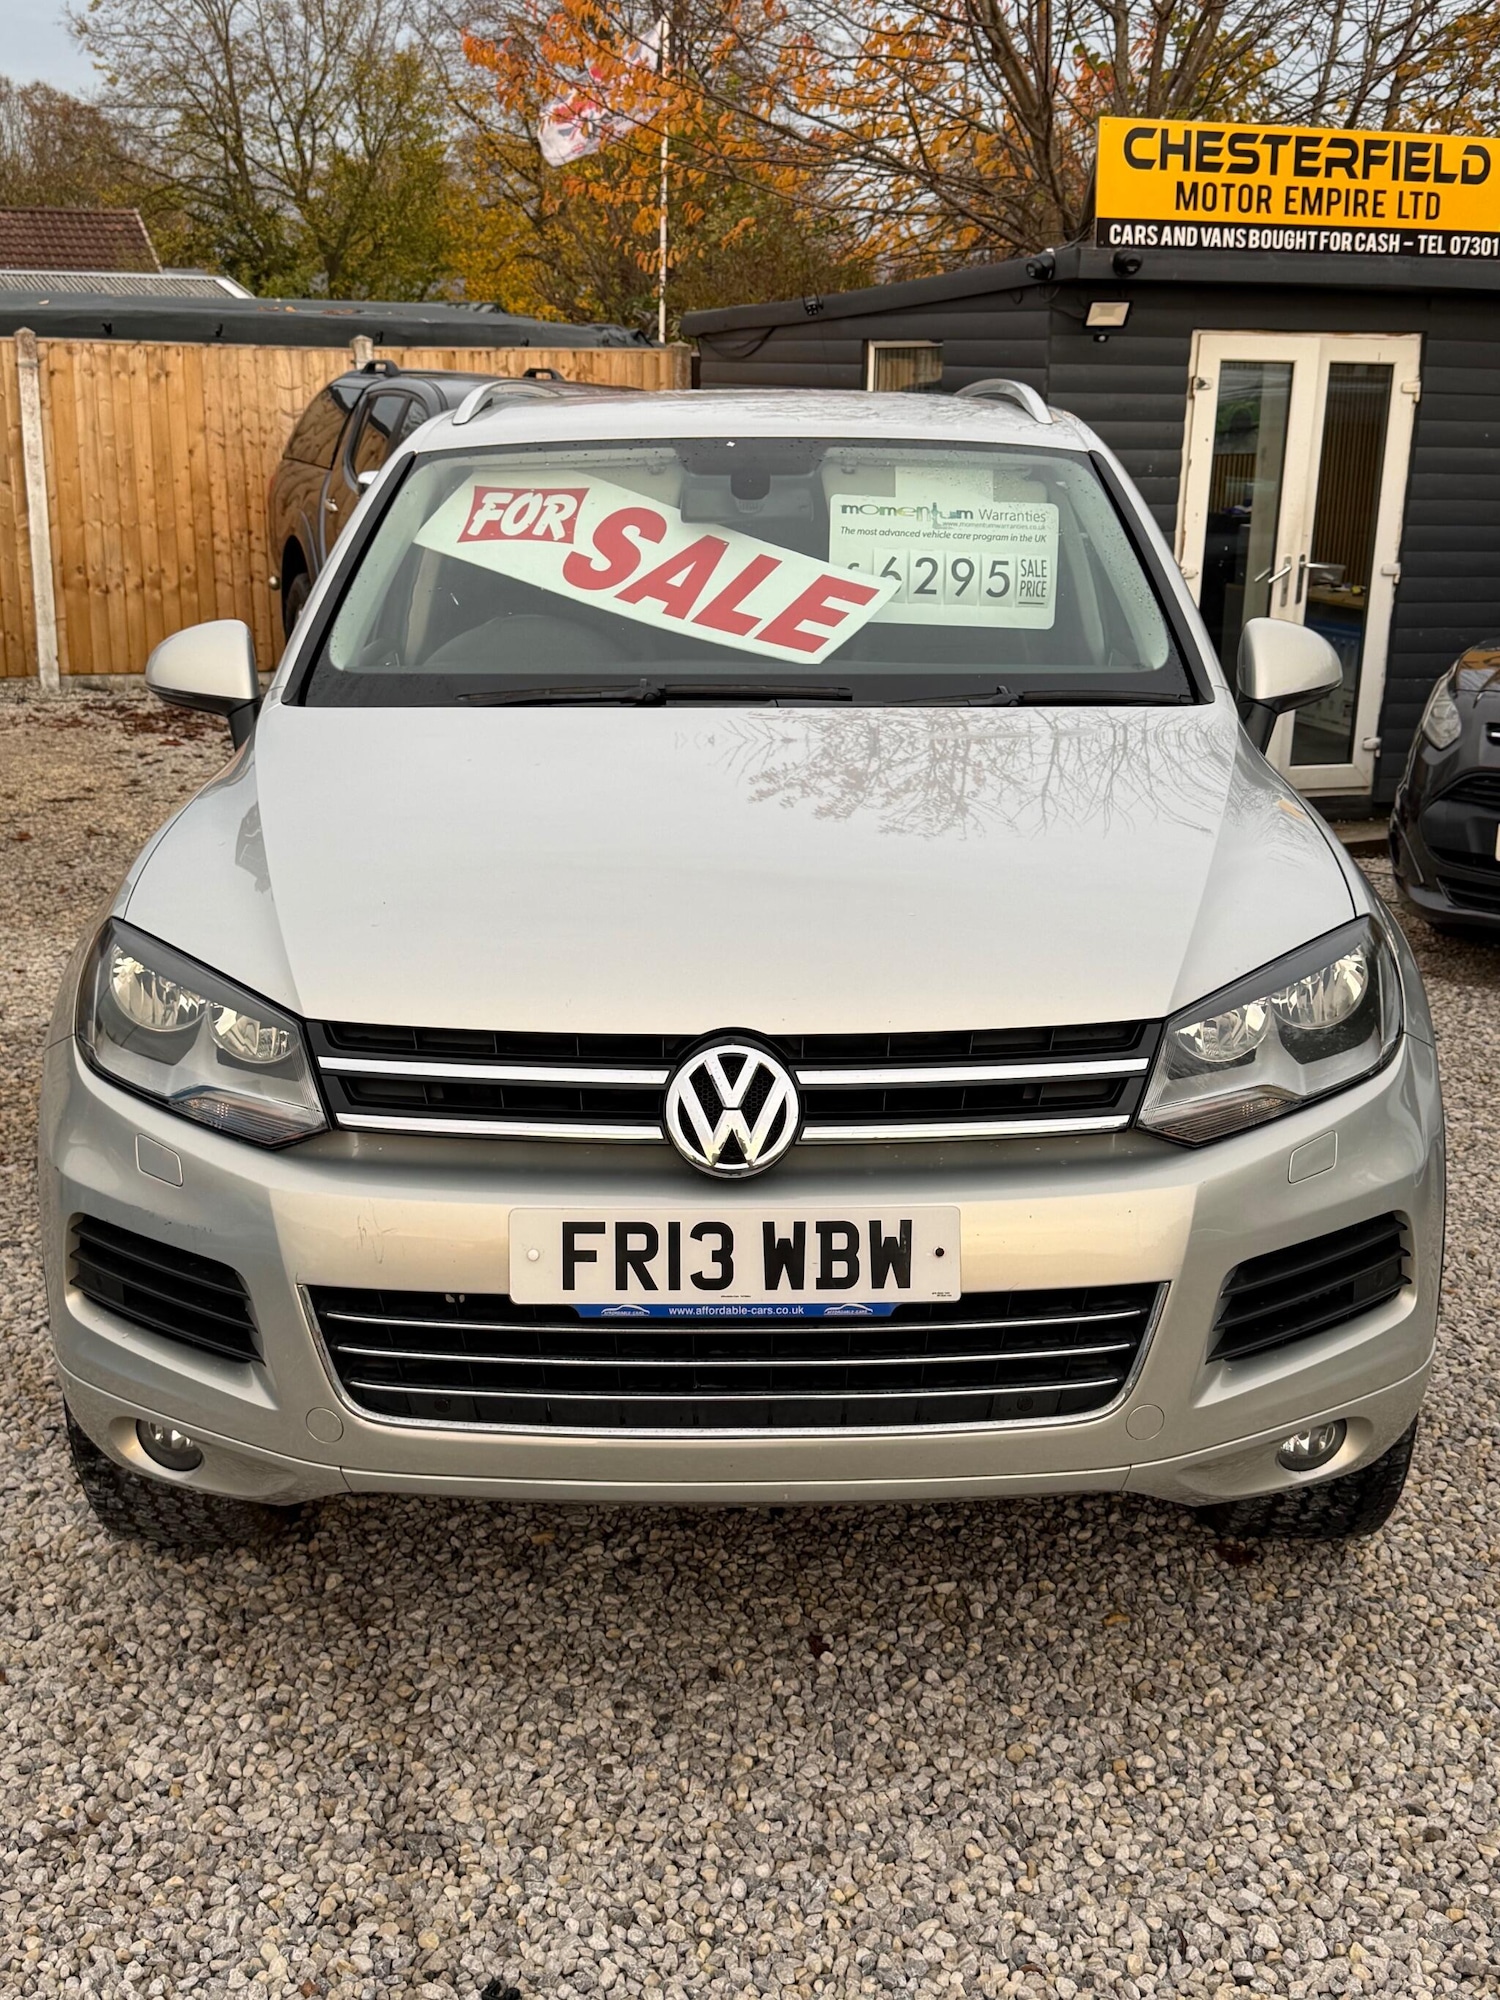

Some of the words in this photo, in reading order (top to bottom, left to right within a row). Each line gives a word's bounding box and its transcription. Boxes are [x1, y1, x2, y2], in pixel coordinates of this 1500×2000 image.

[1123, 127, 1491, 185] CHESTERFIELD
[1174, 181, 1272, 215] MOTOR
[1284, 186, 1387, 218] EMPIRE
[1397, 190, 1441, 220] LTD
[1109, 224, 1158, 246] CARS
[1160, 225, 1198, 247] AND
[1200, 226, 1246, 248] VANS
[1248, 228, 1318, 250] BOUGHT
[1319, 230, 1353, 251] FOR
[1354, 232, 1400, 253] CASH
[1418, 234, 1446, 254] TEL
[1450, 236, 1500, 256] 07301
[467, 489, 578, 541] FOR
[841, 502, 974, 529] momentum
[979, 508, 1046, 523] Warranties
[841, 526, 855, 535] The
[857, 528, 877, 536] most
[878, 528, 921, 538] advanced
[922, 530, 951, 539] vehicle
[952, 532, 971, 540] care
[972, 533, 1009, 542] program
[1010, 533, 1018, 541] in
[1019, 533, 1032, 542] the
[1034, 534, 1047, 543] UK
[562, 507, 880, 654] SALE
[1020, 559, 1048, 578] SALE
[1018, 580, 1047, 598] PRICE
[562, 1220, 734, 1291] FR13
[762, 1219, 913, 1290] WBW
[668, 1305, 805, 1317] www.affordable-cars.co.uk
